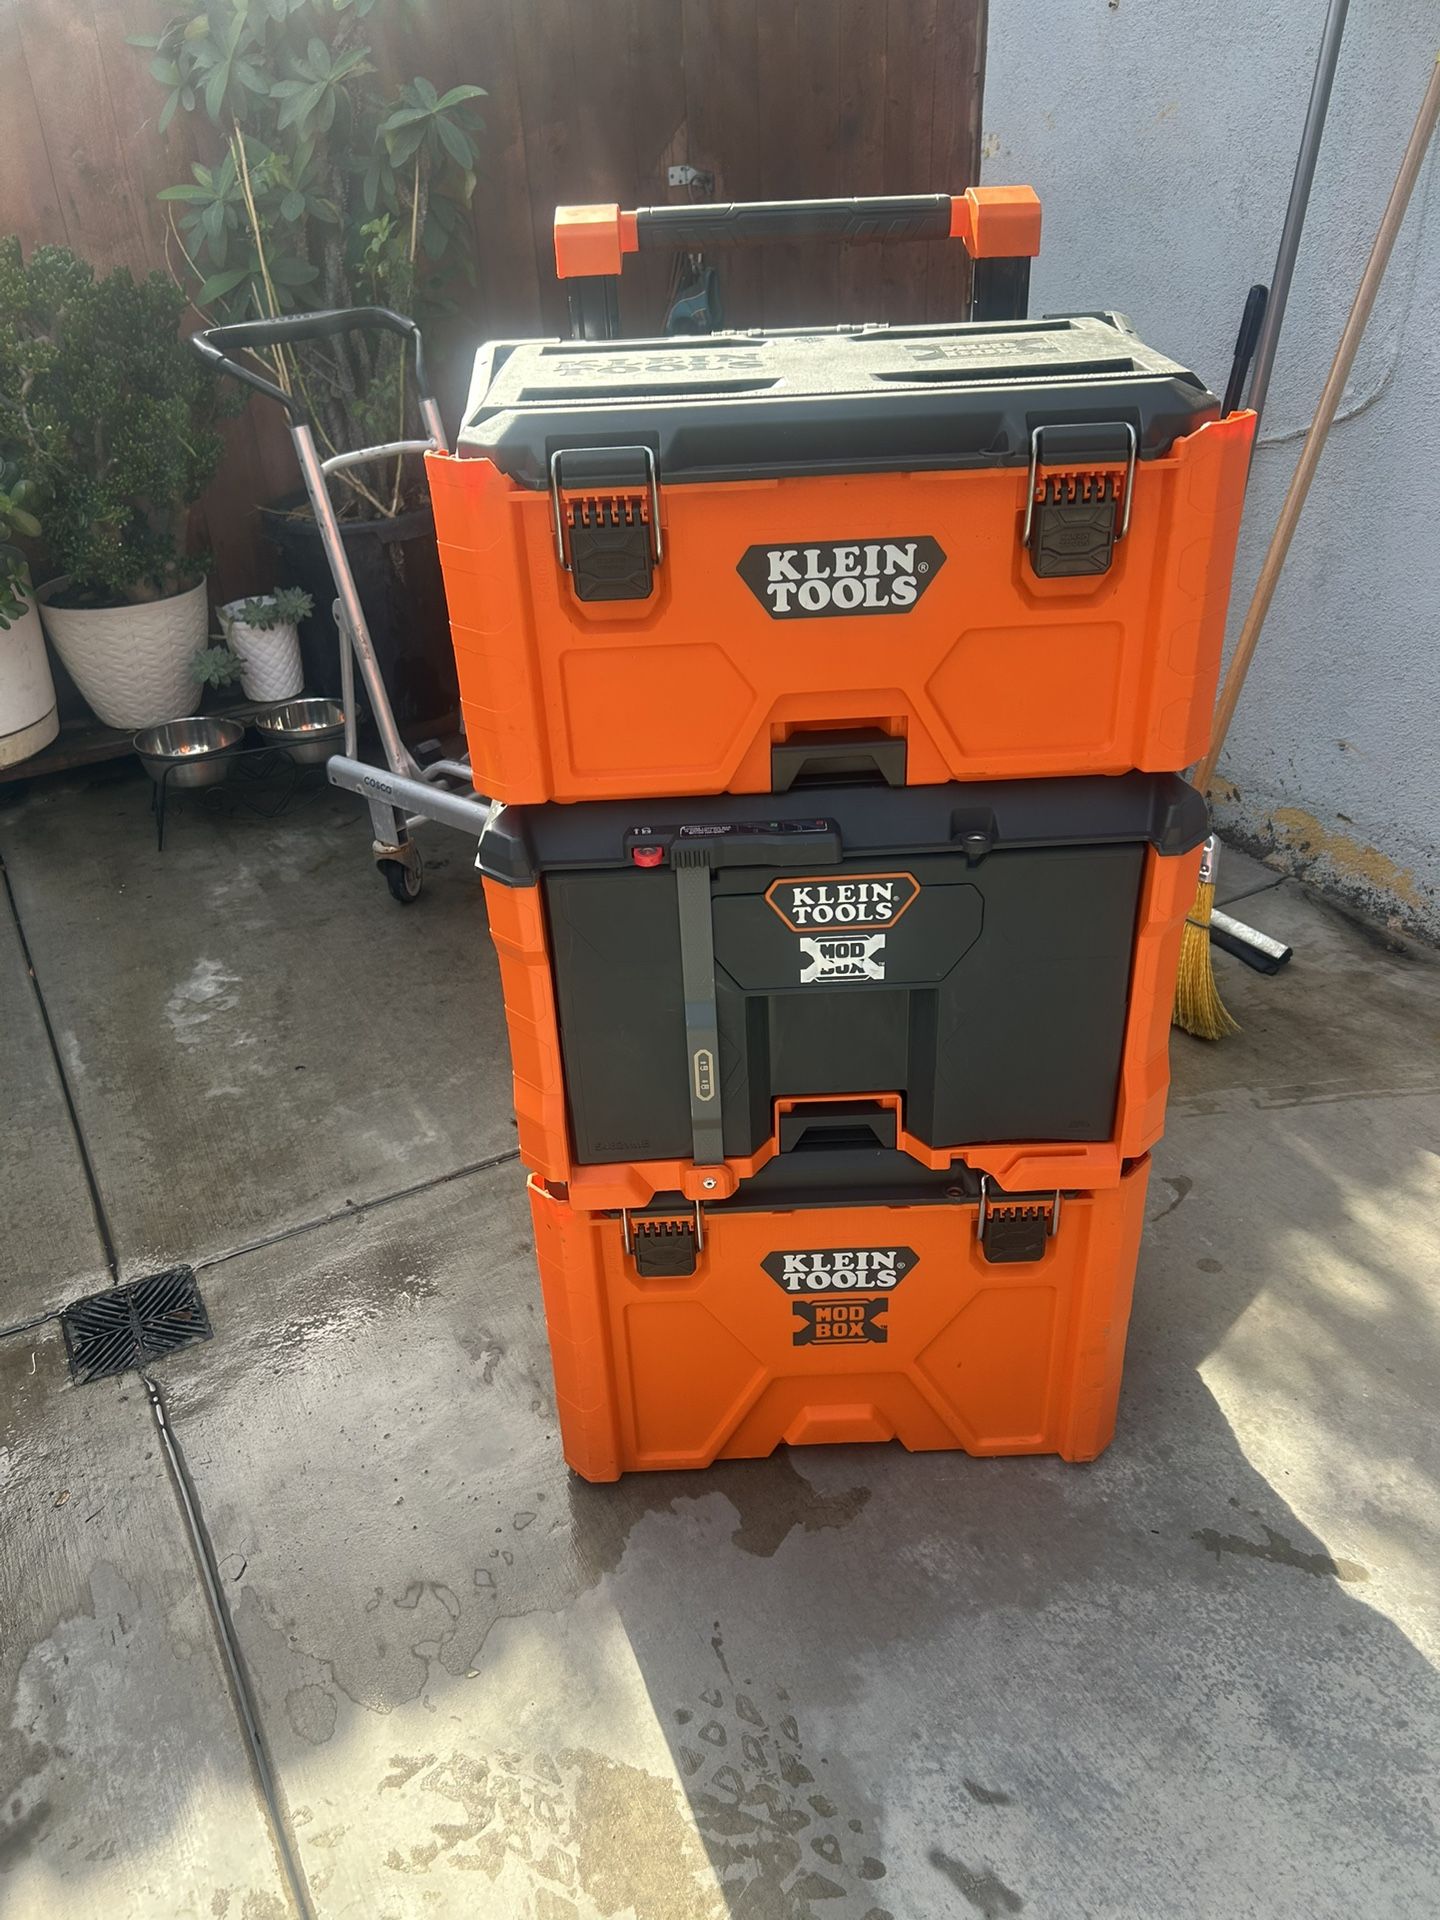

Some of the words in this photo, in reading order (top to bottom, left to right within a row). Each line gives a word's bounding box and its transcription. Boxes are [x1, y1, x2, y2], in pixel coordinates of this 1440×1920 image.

[767, 543, 918, 581] KLEIN
[767, 576, 918, 612] TOOLS
[792, 883, 894, 905] KLEIN
[792, 902, 893, 924] TOOLS
[820, 943, 865, 958] MOD
[783, 1251, 897, 1273] KLEIN
[783, 1270, 897, 1290] TOOLS
[816, 1306, 865, 1322] MOD
[816, 1322, 865, 1338] BOX
